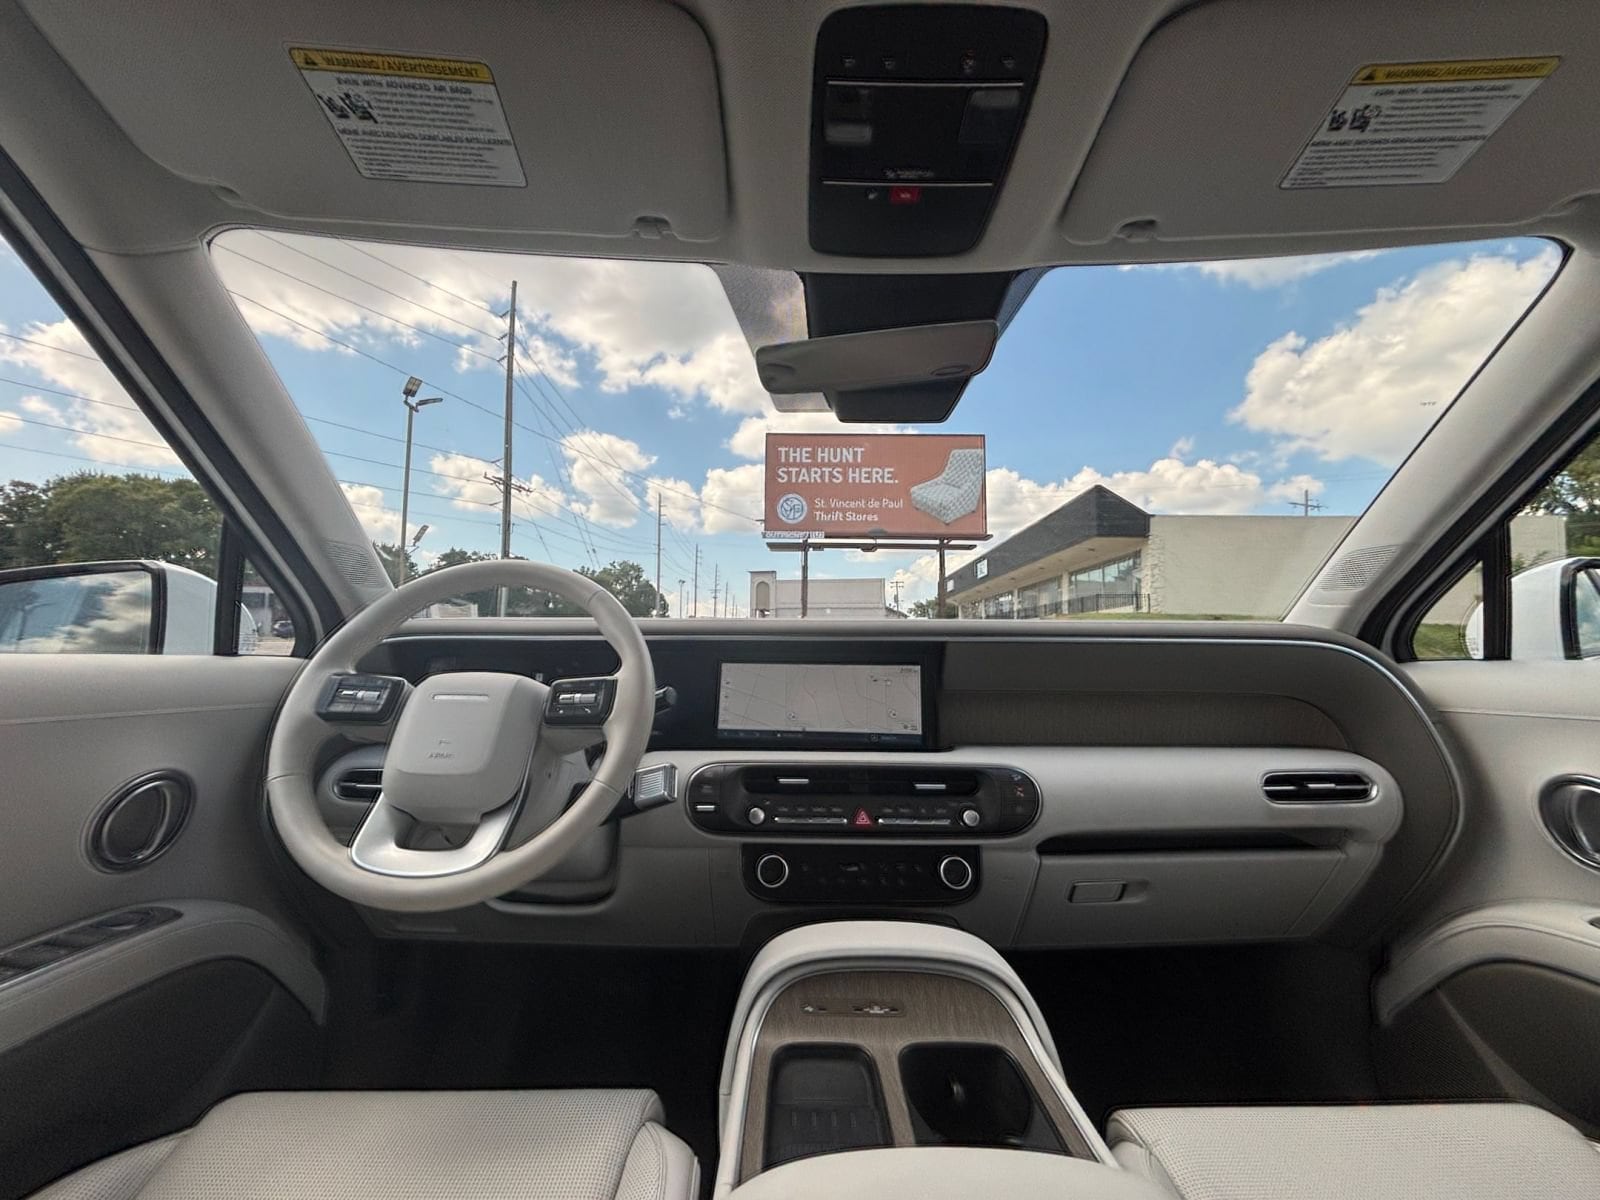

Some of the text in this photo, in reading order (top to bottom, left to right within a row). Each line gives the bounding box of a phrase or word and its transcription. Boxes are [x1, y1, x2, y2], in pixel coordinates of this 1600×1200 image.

[778, 447, 865, 463] THE HUNT
[777, 468, 899, 484] STARTS HERE.
[814, 498, 829, 509] St.
[830, 498, 865, 509] Vincent
[867, 498, 880, 509] de
[882, 498, 903, 509] Paul
[814, 511, 879, 522] Thrift Stores
